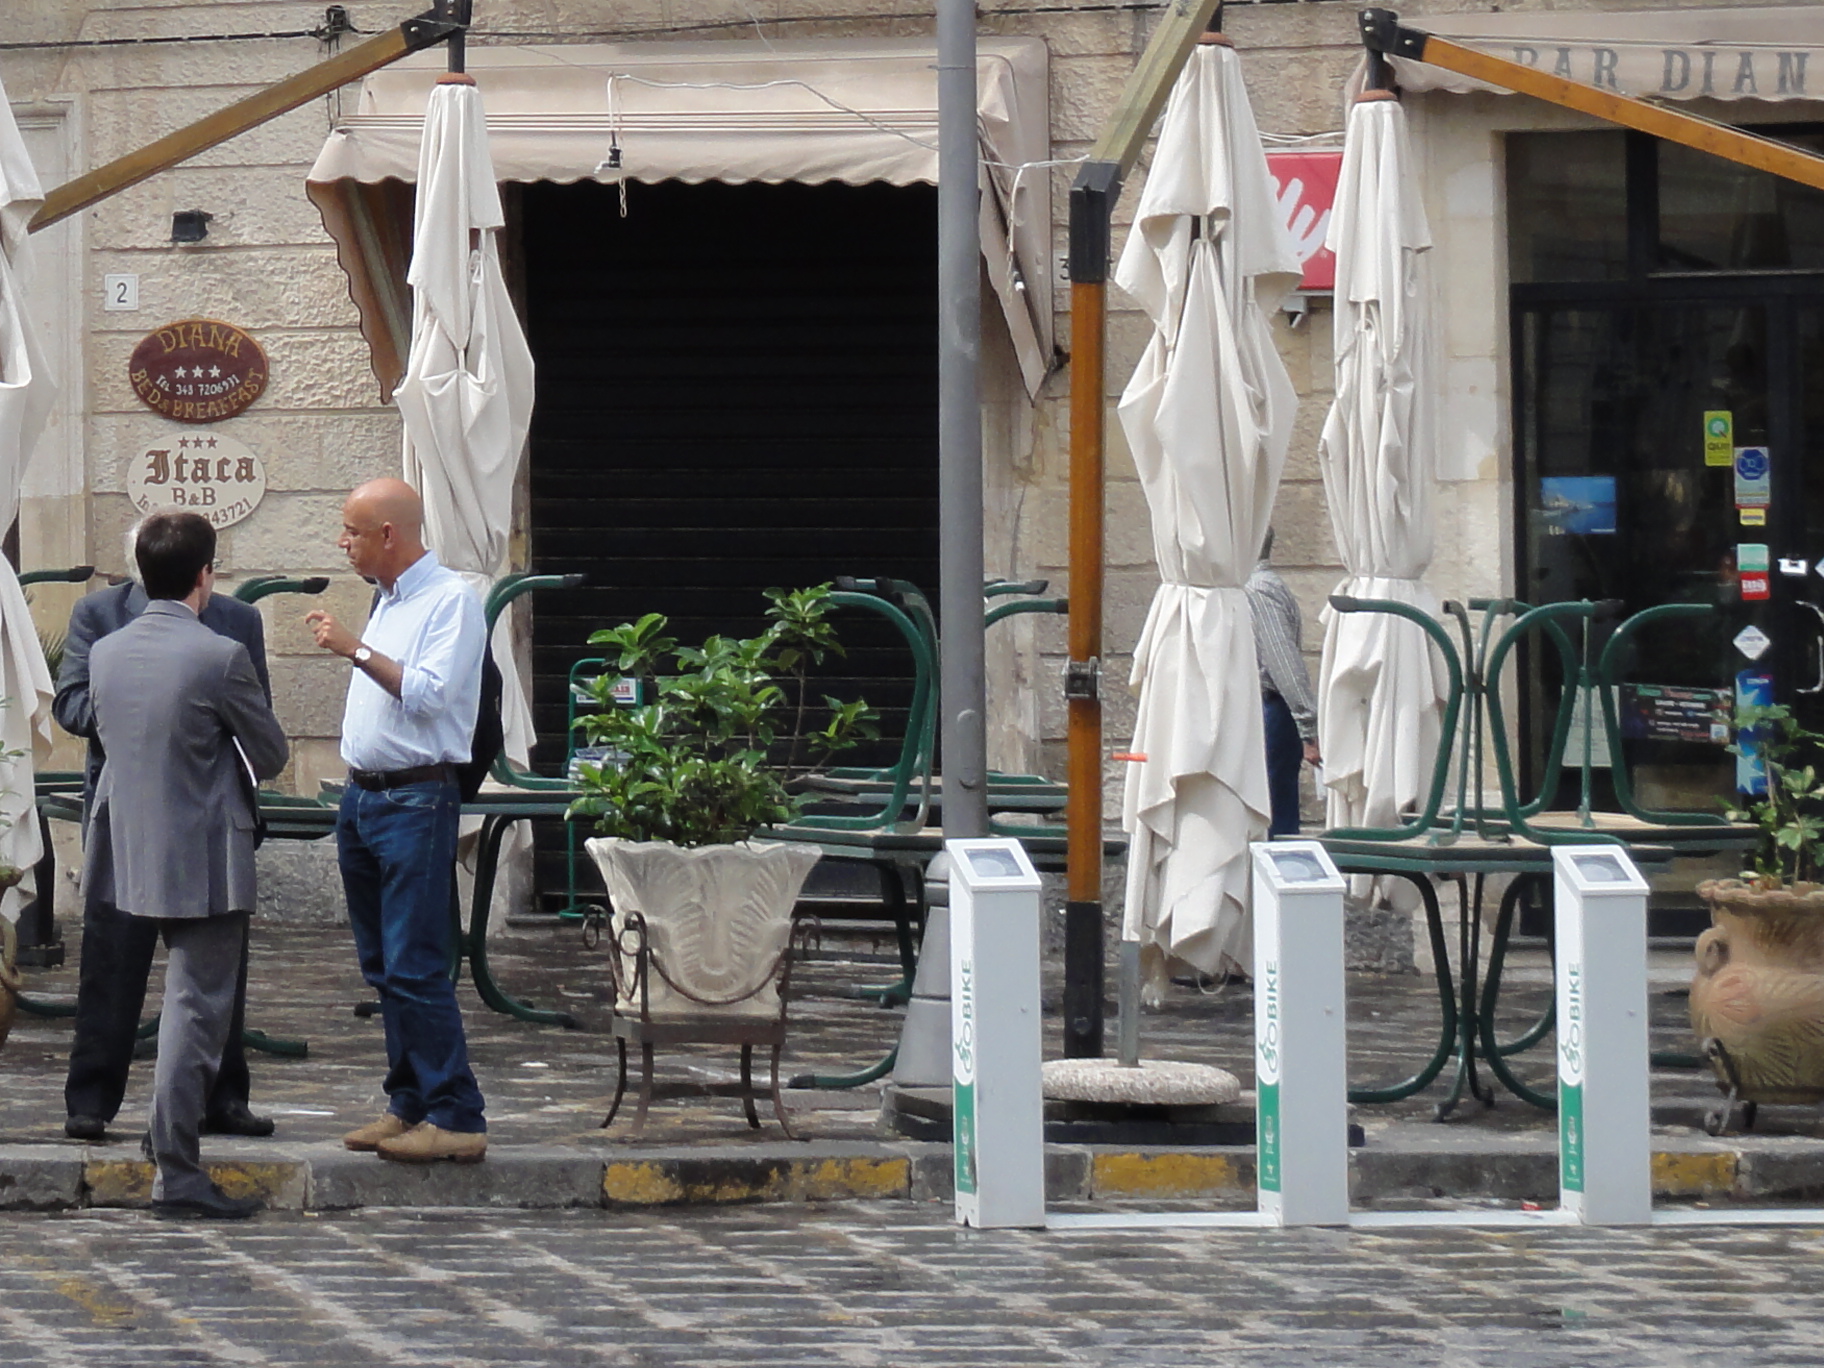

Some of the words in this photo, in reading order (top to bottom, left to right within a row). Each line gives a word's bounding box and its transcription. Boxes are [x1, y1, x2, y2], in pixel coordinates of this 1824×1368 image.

[117, 282, 127, 303] 2
[157, 323, 243, 358] DIANA
[131, 368, 161, 404] BED
[172, 367, 263, 419] BREAKFAST
[143, 449, 256, 485] Itaca
[171, 487, 217, 506] B&B
